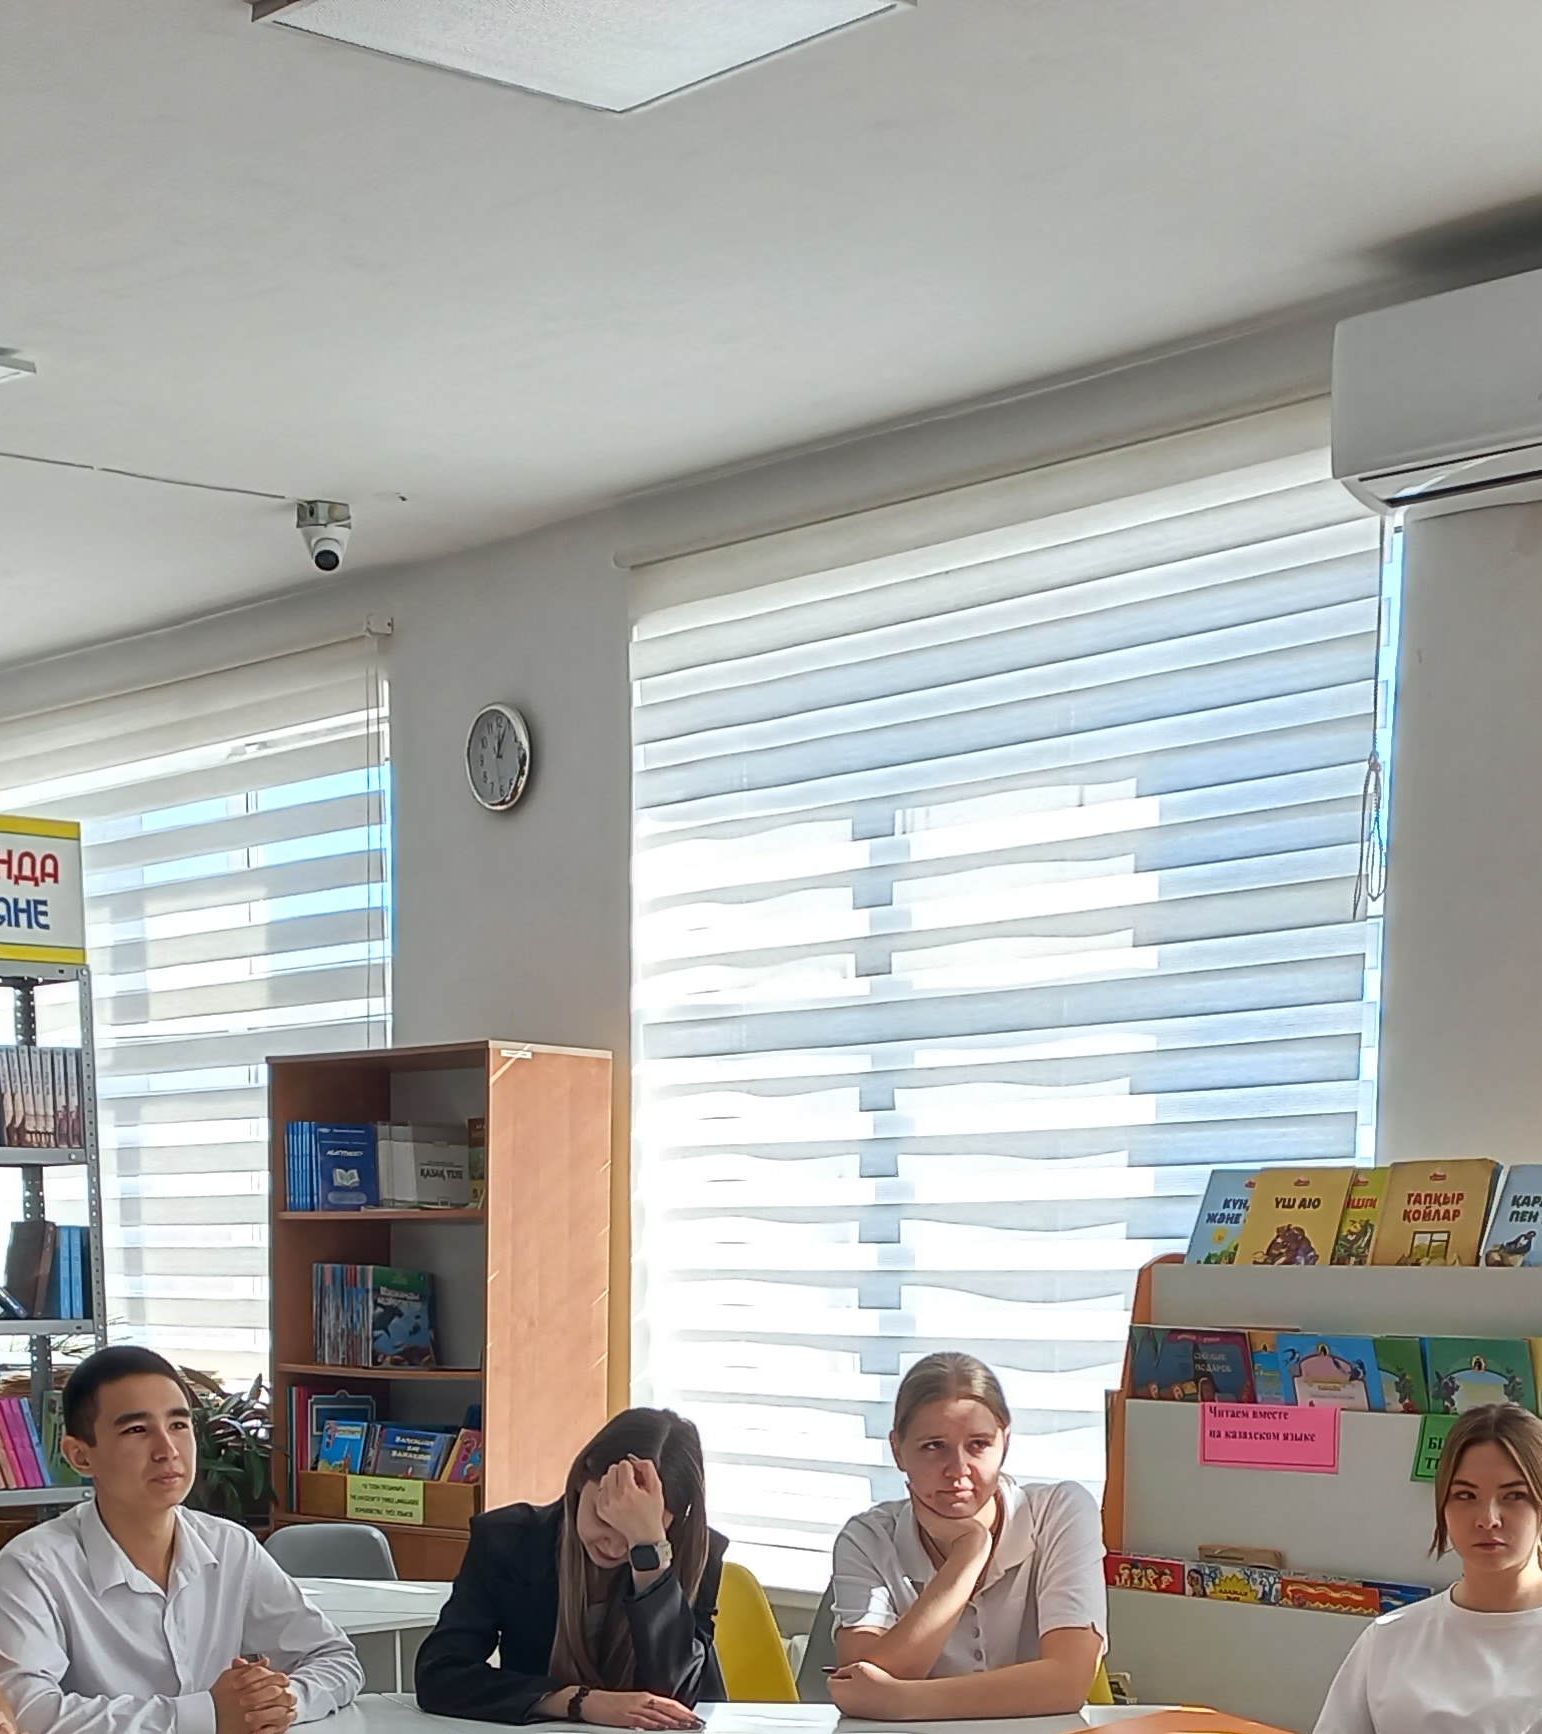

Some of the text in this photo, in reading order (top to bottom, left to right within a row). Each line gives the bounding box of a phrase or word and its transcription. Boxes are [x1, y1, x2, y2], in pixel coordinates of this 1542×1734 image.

[1208, 1405, 1289, 1421] Читаем вместе
[1224, 1430, 1280, 1442] казахском
[1282, 1431, 1317, 1443] языке
